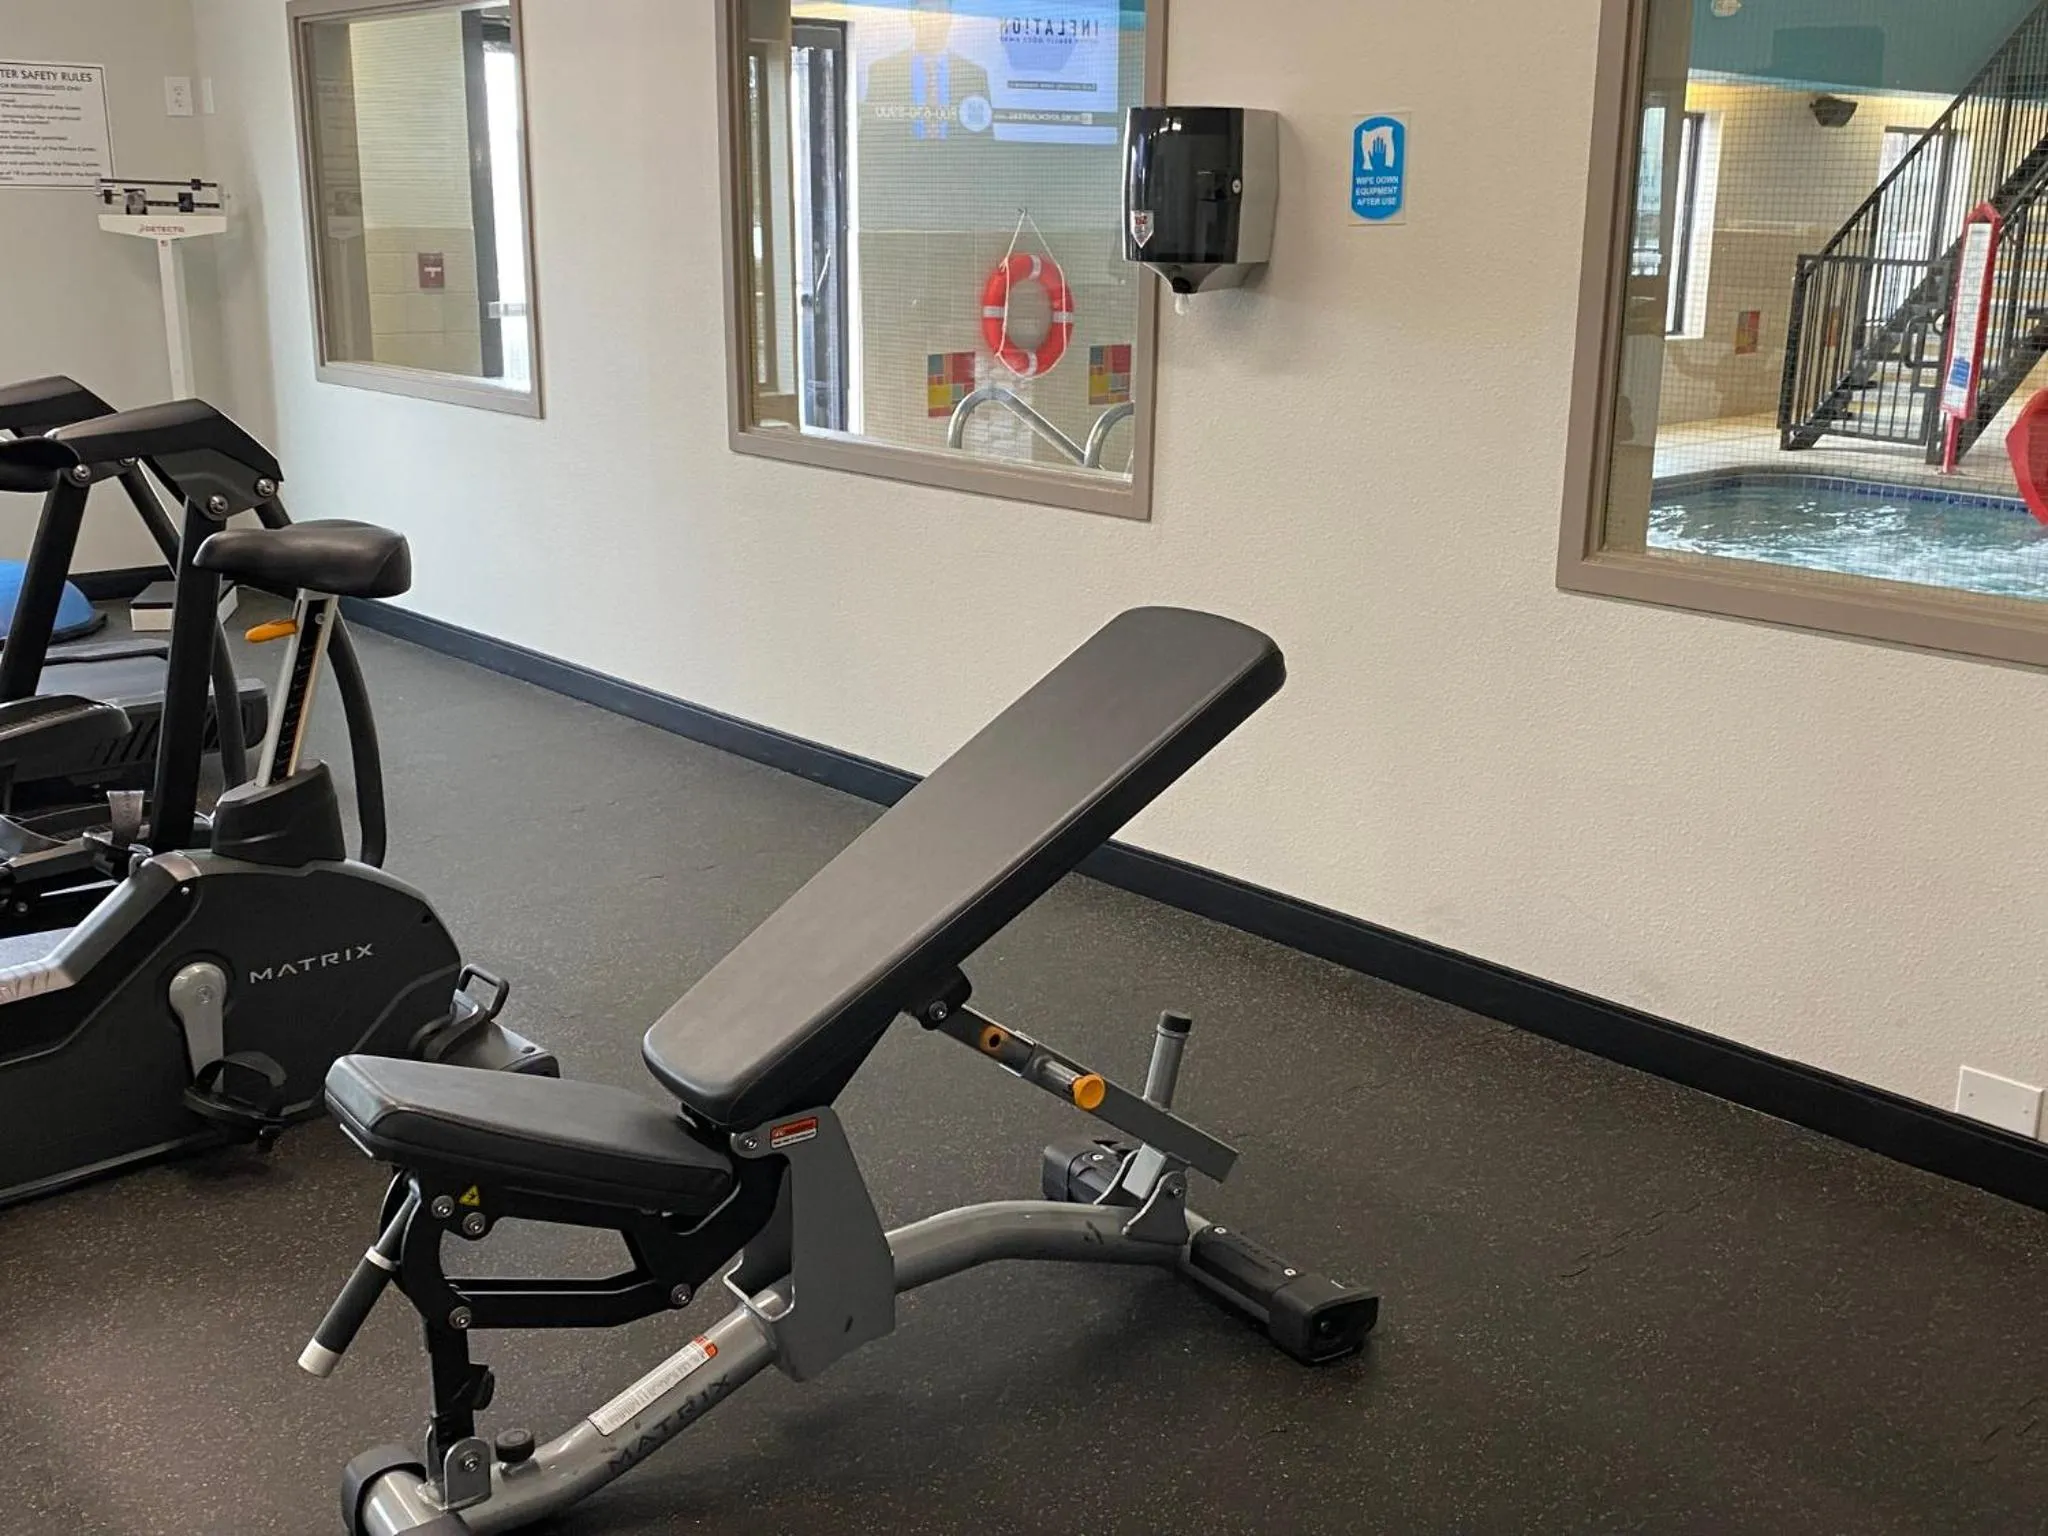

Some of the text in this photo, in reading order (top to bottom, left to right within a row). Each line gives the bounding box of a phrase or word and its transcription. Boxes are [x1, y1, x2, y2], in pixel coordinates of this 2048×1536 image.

[22, 70, 57, 80] SAFETY
[61, 71, 93, 82] RULES
[1355, 175, 1399, 185] WIPE DOWN
[1355, 186, 1398, 196] EQUIPMENT
[1356, 197, 1397, 206] AFTER USE
[249, 943, 373, 984] MATRIX
[607, 1374, 730, 1473] MATRIX
